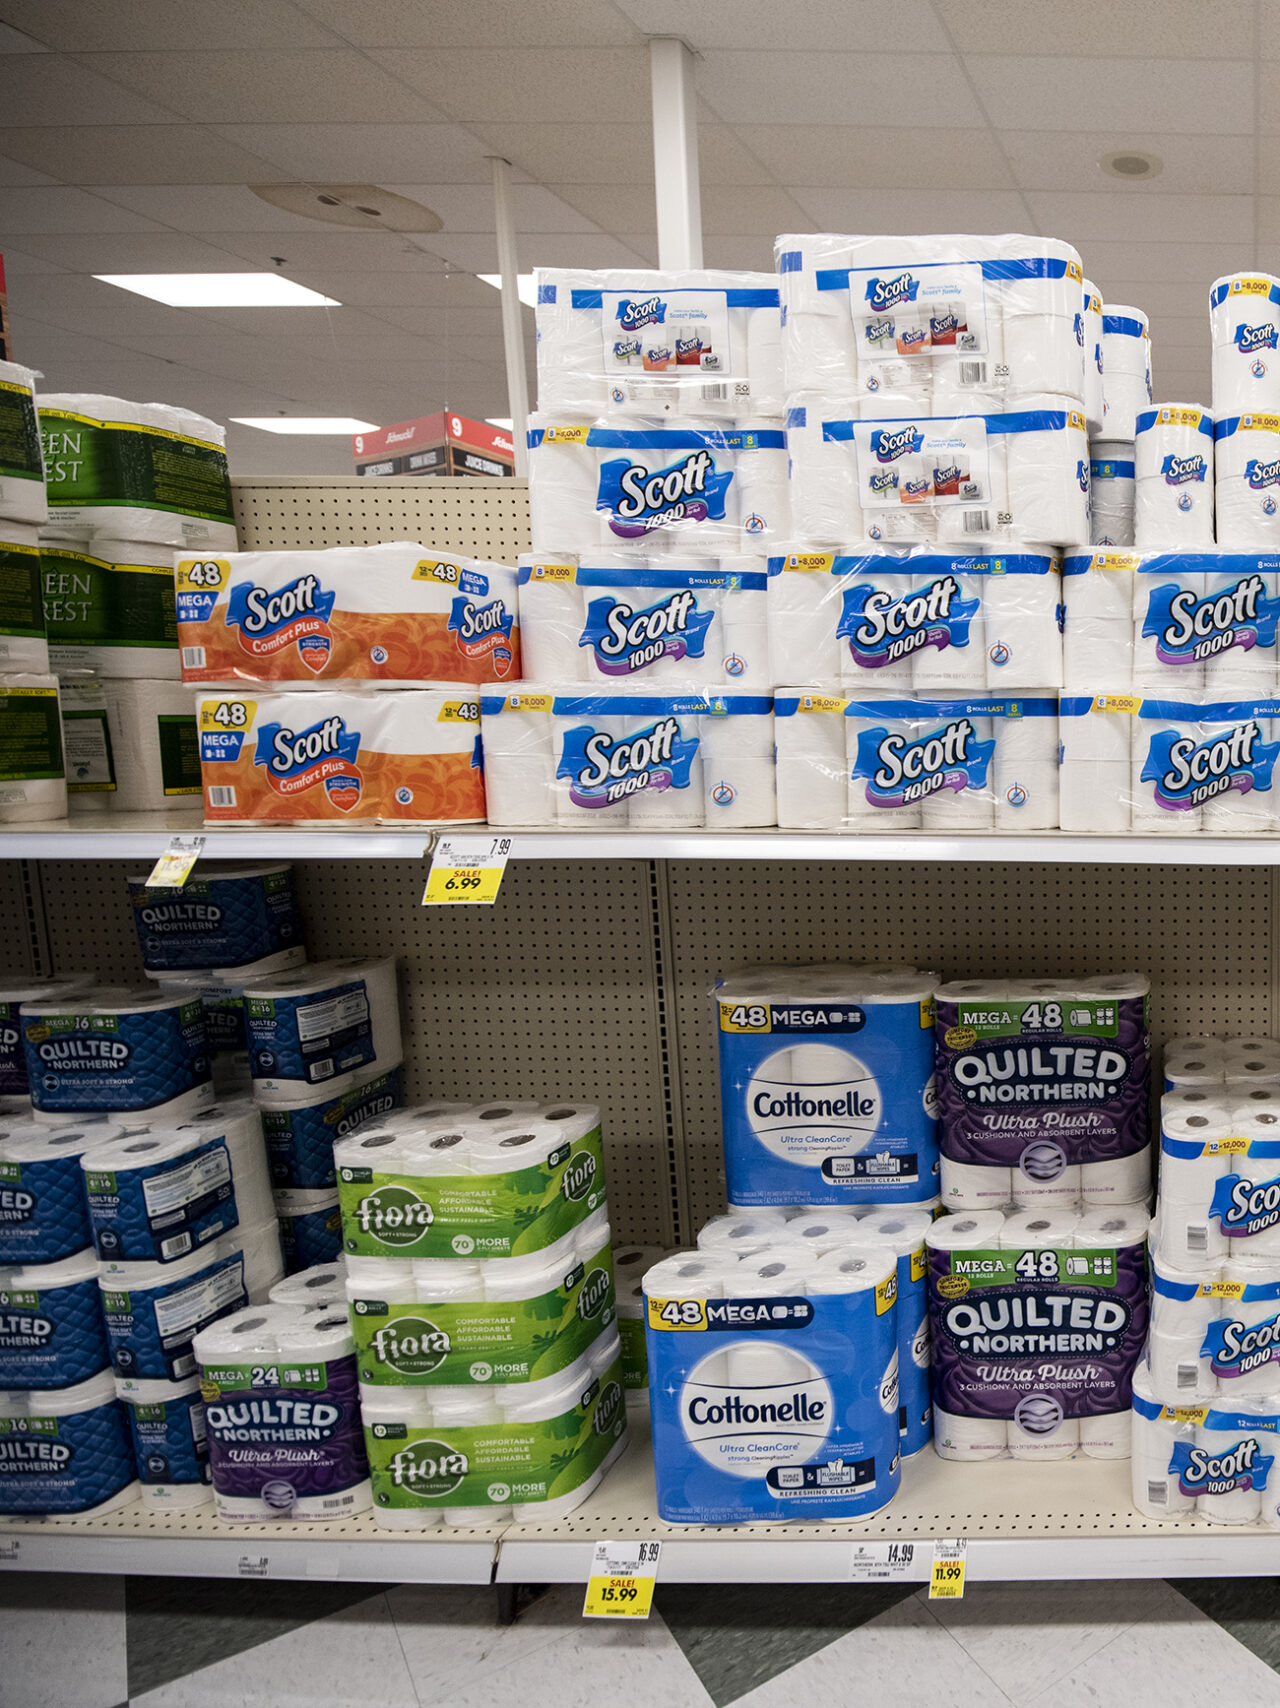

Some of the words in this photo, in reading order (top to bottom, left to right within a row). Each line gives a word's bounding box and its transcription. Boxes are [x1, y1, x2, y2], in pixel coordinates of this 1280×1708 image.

[452, 418, 462, 437] 9
[355, 437, 363, 453] 9
[617, 451, 711, 517] Scott
[178, 595, 212, 607] MEGA
[244, 575, 316, 632] Scott
[856, 576, 957, 645] Scott
[1164, 575, 1263, 647] Scott
[460, 600, 503, 638] Scott
[600, 590, 694, 655] Scott
[252, 632, 293, 653] Comfort
[295, 621, 319, 635] Plus
[886, 628, 926, 662] 1000
[1193, 630, 1234, 661] 1000
[203, 735, 239, 746] MEGA
[272, 717, 341, 771] Scott
[579, 717, 678, 787] Scott
[874, 719, 971, 788] Scott
[1163, 722, 1259, 790] Scott
[280, 773, 320, 792] Comfort
[322, 762, 344, 774] Plus
[903, 772, 944, 803] 1000
[490, 838, 511, 856] 7.99
[444, 878, 481, 891] 6.99
[453, 870, 481, 878] SALE!
[142, 903, 221, 924] QUILTED
[730, 1005, 768, 1027] 48
[772, 1010, 828, 1025] MEGA
[963, 1012, 1012, 1024] MEGA
[1021, 1003, 1063, 1029] 48
[39, 1040, 129, 1061] QUILTED
[954, 1047, 1127, 1086] QUILTED
[979, 1082, 1105, 1103] NORTHERN
[753, 1091, 875, 1117] Cottonelle
[984, 1114, 1040, 1130] Ultra
[1043, 1112, 1101, 1130] Plush
[973, 1131, 1015, 1139] CUSHIONY
[1038, 1129, 1086, 1137] ABSORBENT
[354, 1197, 434, 1231] fiora
[476, 1237, 510, 1247] MORE
[956, 1260, 1006, 1273] MEGA
[1015, 1251, 1059, 1278] 48
[456, 1317, 515, 1326] COMFORTABLE
[661, 1301, 703, 1323] 48
[707, 1306, 771, 1321] MEGA
[946, 1296, 1126, 1336] QUILTED
[371, 1328, 451, 1361] fiora
[457, 1334, 513, 1342] SUSTAINABLE
[973, 1334, 1103, 1354] NORTHERN
[494, 1363, 528, 1373] MORE
[1239, 1347, 1271, 1373] 1000
[209, 1371, 244, 1381] MEGA
[251, 1366, 279, 1387] 24
[977, 1366, 1035, 1381] Ultra
[1038, 1365, 1100, 1382] Plush
[207, 1401, 338, 1427] QUILTED
[688, 1393, 826, 1425] Cottonelle
[223, 1427, 320, 1442] NORTHERN
[229, 1449, 270, 1462] Ultra
[274, 1448, 320, 1462] Plush
[720, 1444, 745, 1453] Ultra
[389, 1451, 468, 1485] fiora
[1185, 1438, 1259, 1482] Scott
[1207, 1480, 1234, 1493] 1000
[638, 1543, 659, 1562] 16.99
[887, 1544, 914, 1562] 14.99
[610, 1579, 635, 1588] SALE!
[935, 1568, 962, 1581] 11.99
[601, 1588, 638, 1602] 15.99
